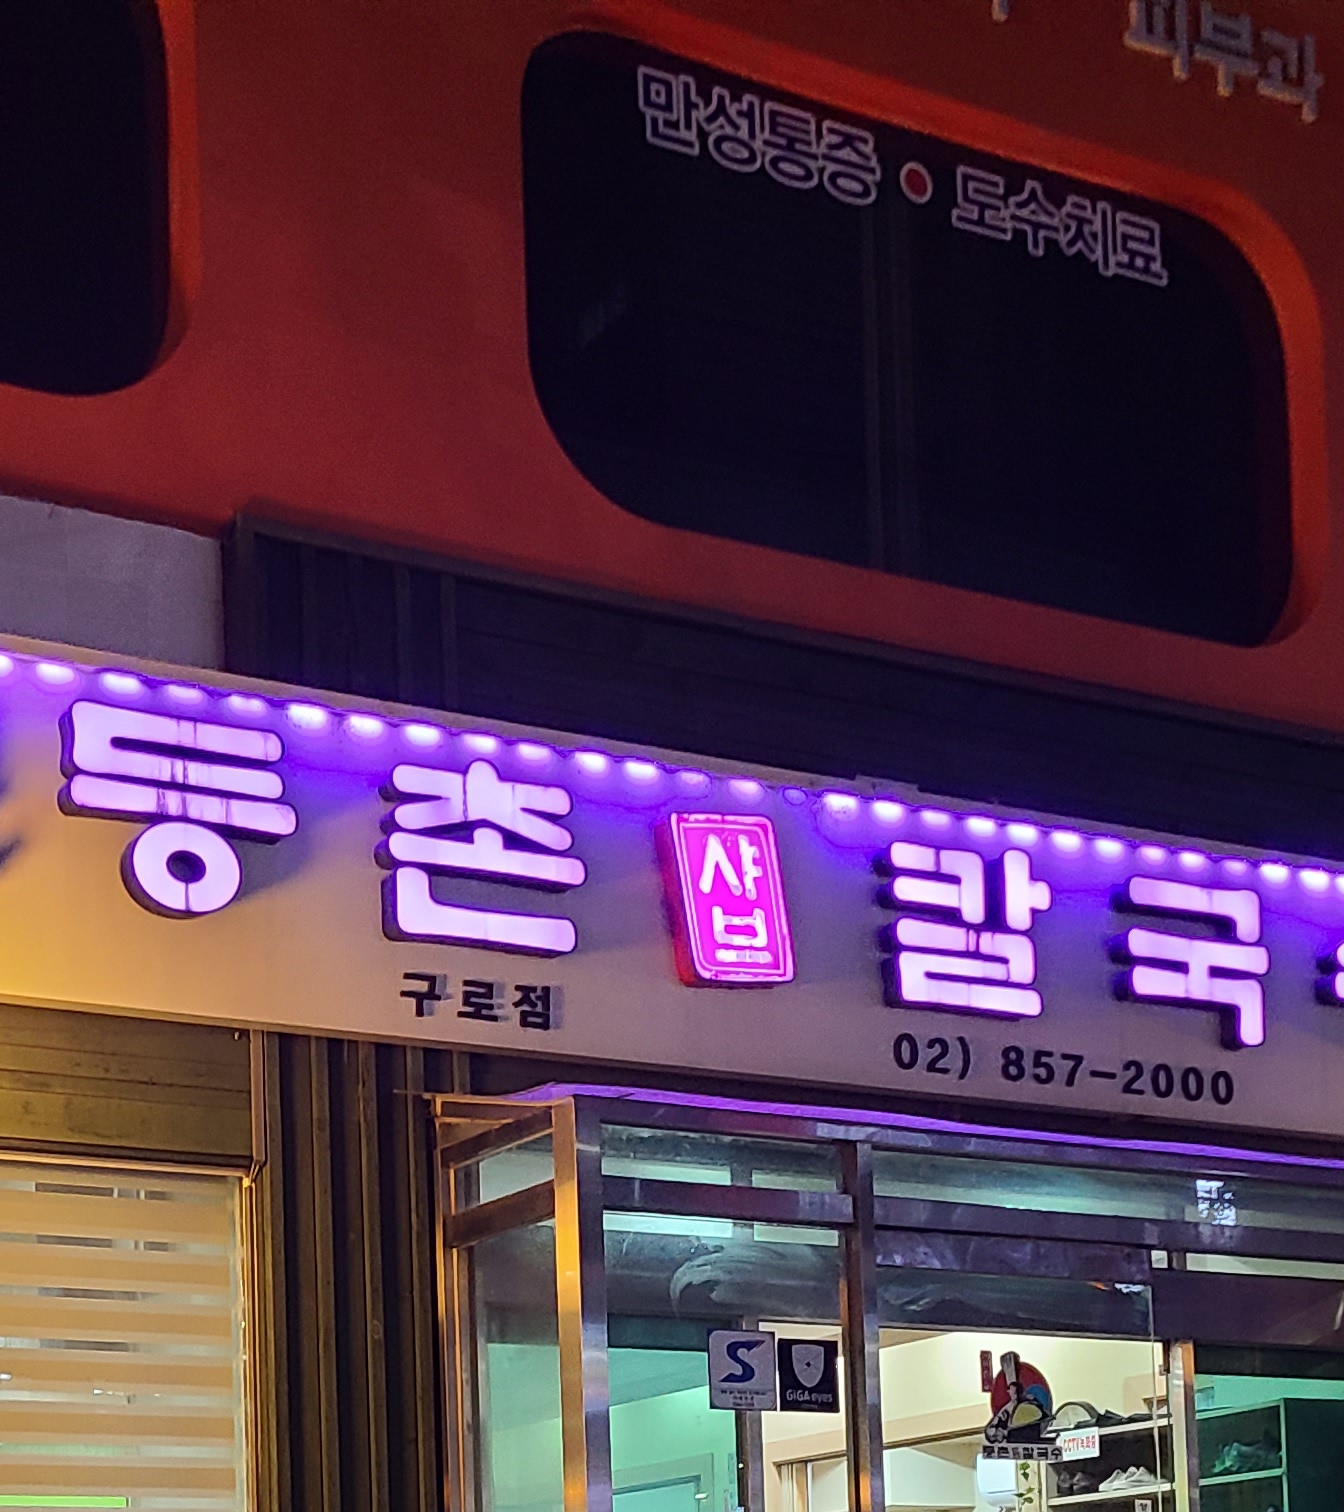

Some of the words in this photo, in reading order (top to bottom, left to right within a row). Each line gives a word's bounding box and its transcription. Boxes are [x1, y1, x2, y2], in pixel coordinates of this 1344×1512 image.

[1123, 0, 1324, 125] 피부과
[636, 65, 882, 206] 만성통증
[951, 164, 1170, 287] 도수치료
[59, 698, 588, 956] 등촌
[398, 971, 553, 1031] 구로점
[893, 1032, 974, 1081] 02)
[1000, 1044, 1235, 1105] 857-2000
